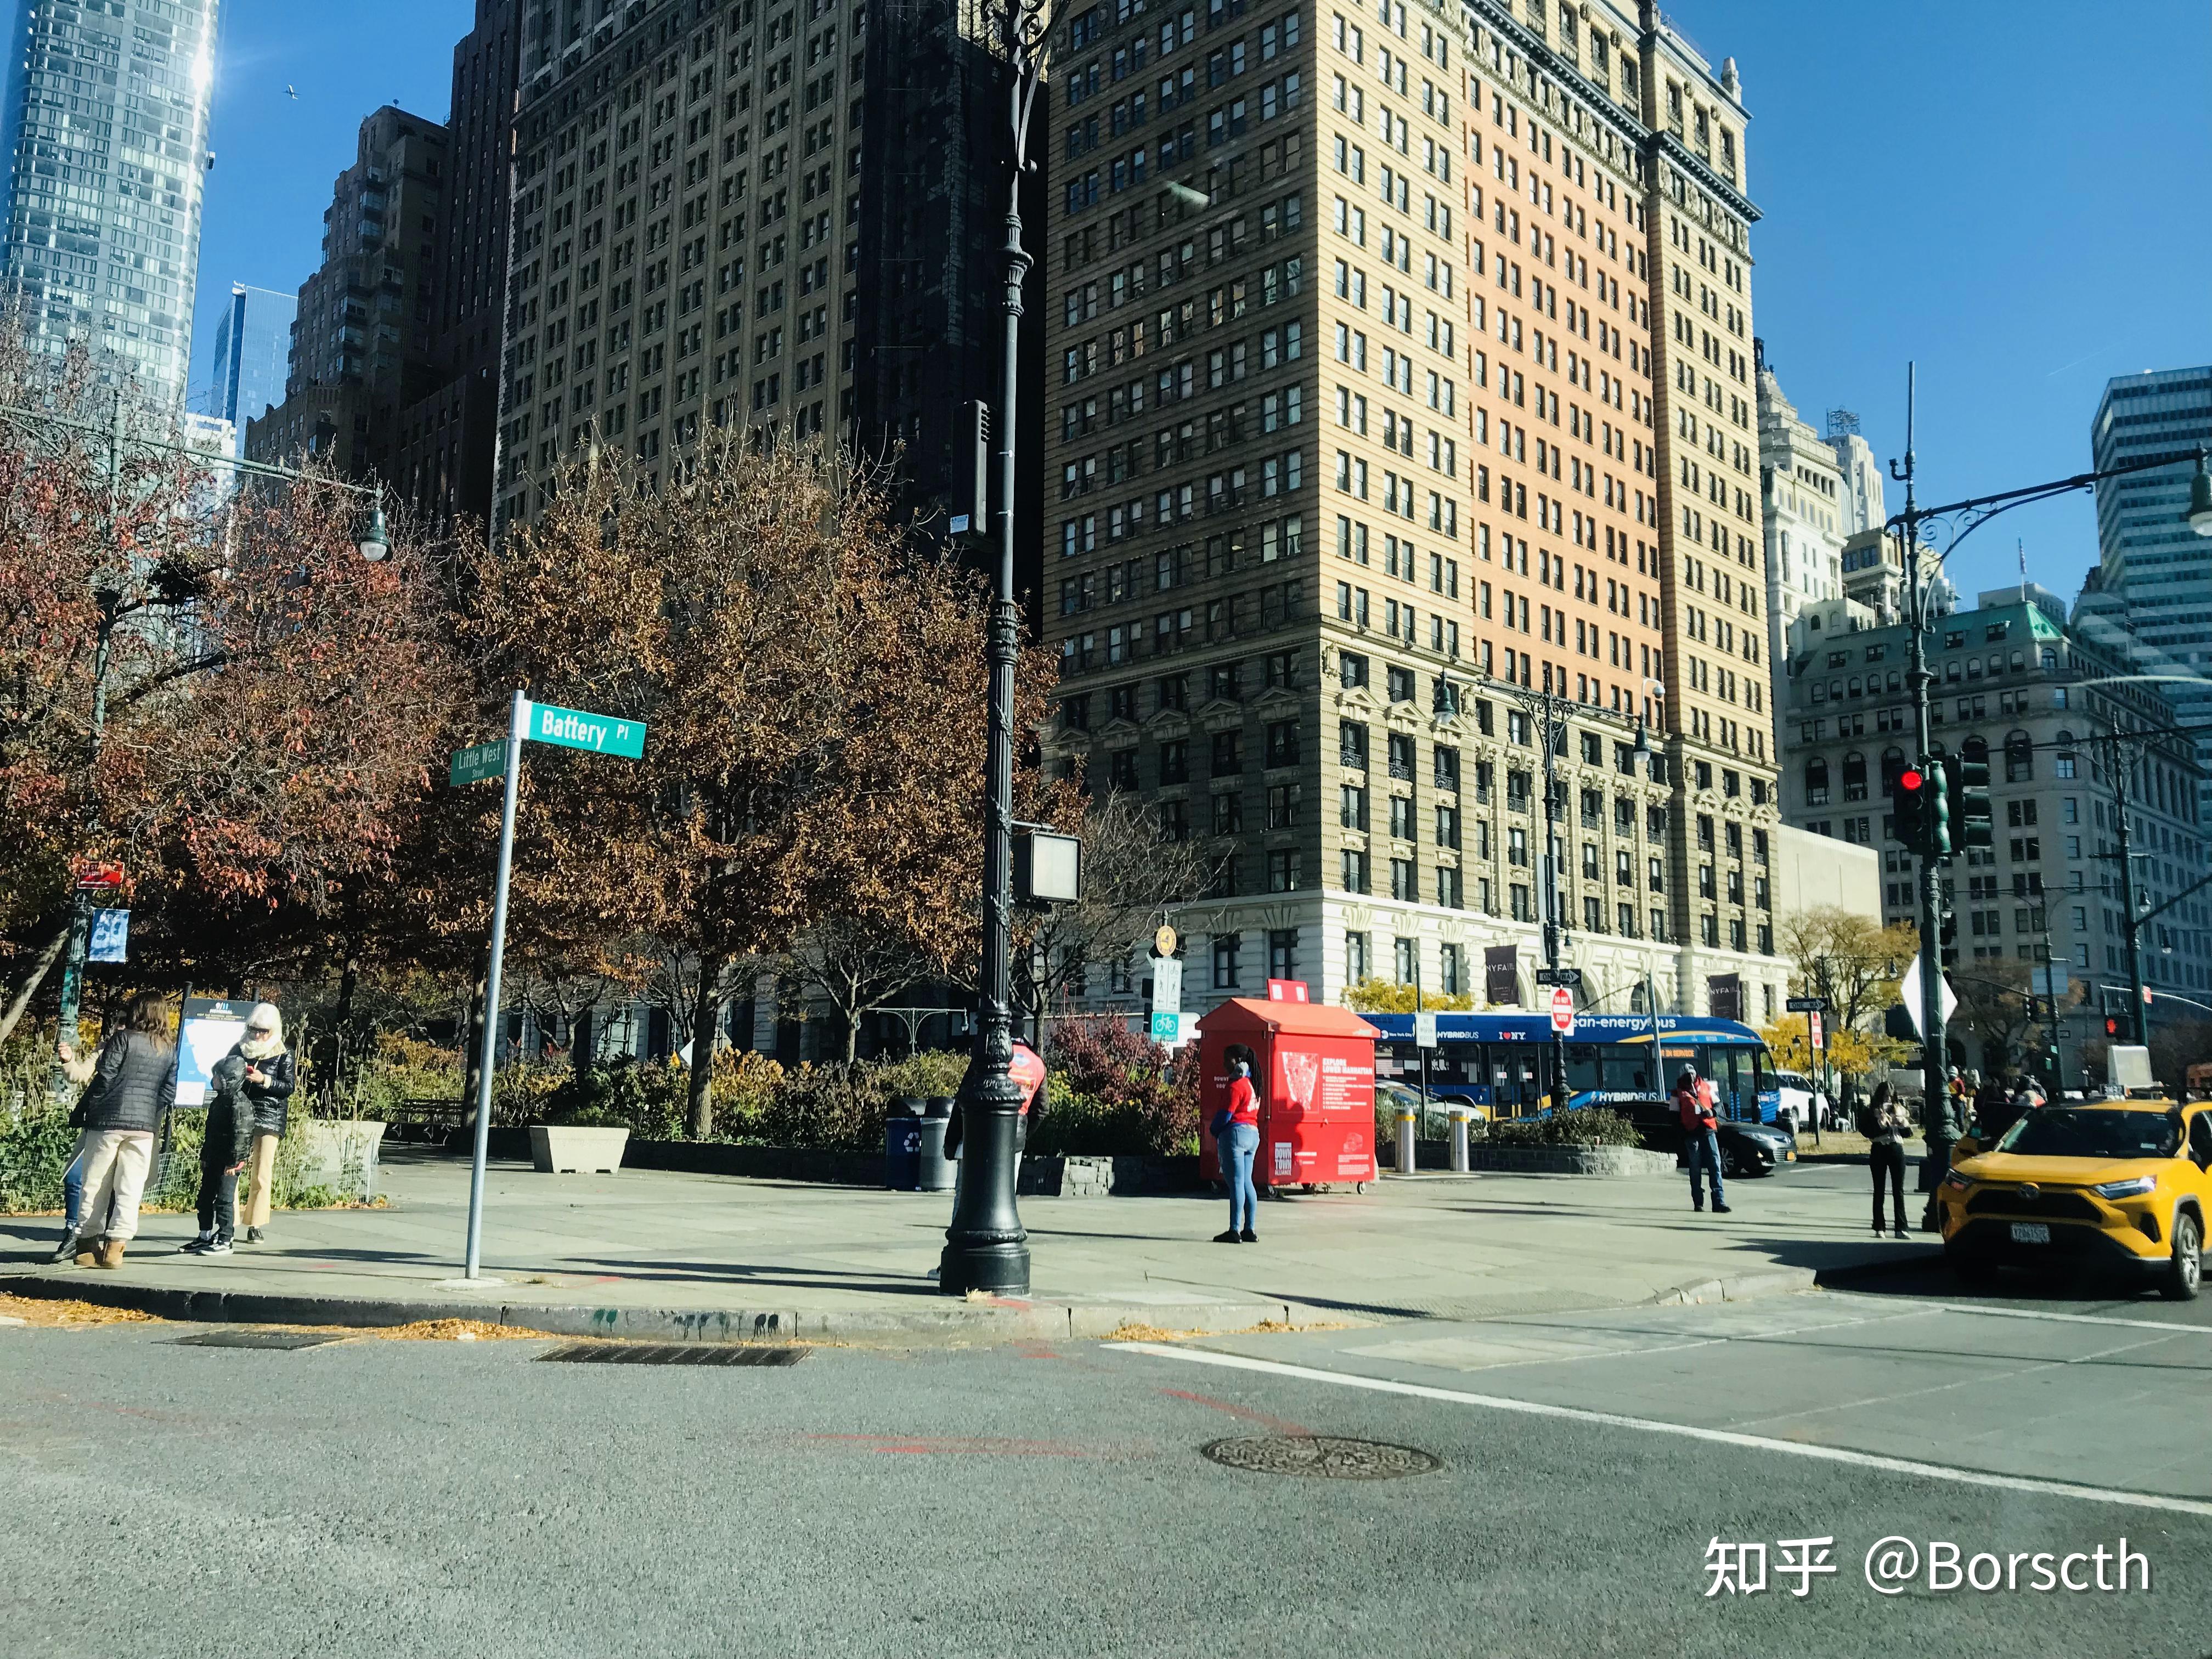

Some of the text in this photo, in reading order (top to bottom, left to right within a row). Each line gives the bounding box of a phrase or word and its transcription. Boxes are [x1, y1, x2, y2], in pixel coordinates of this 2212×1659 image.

[541, 710, 607, 750] Battery
[459, 743, 500, 769] Little West
[1573, 1018, 1647, 1031] ean-energy
[1323, 1057, 1347, 1066] EXPLORE
[1323, 1065, 1373, 1075] LOWER MANHATTAN
[1599, 1092, 1658, 1102] HYBRIDBUS
[1275, 1148, 1291, 1159] DOWN
[1275, 1158, 1291, 1169] TOWN
